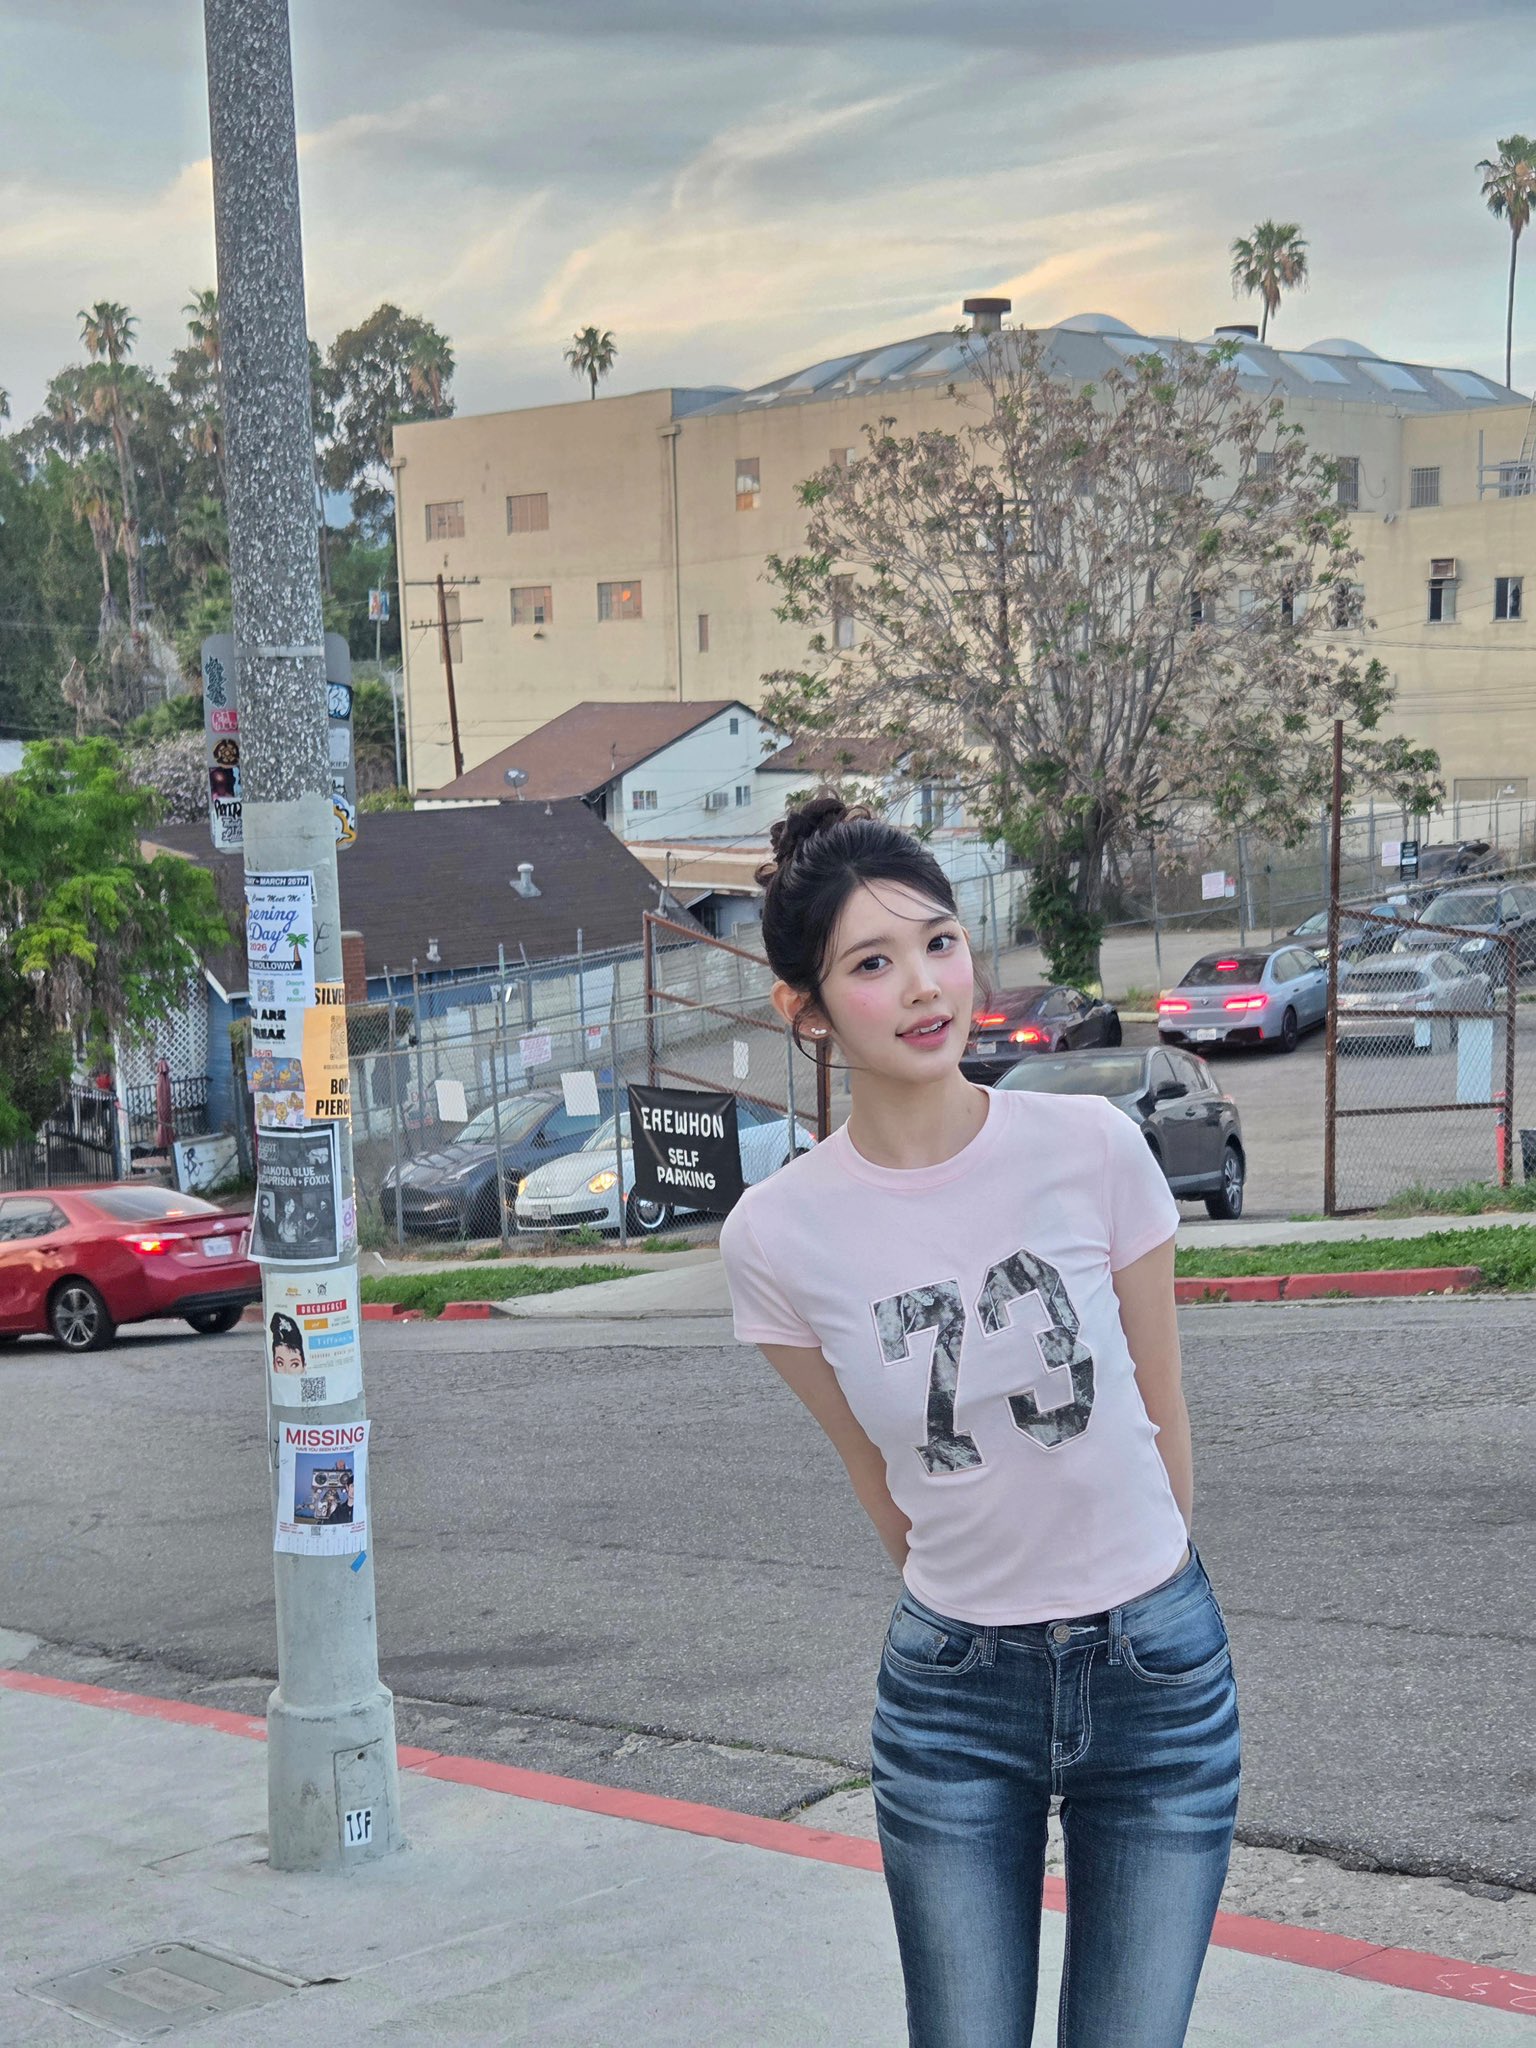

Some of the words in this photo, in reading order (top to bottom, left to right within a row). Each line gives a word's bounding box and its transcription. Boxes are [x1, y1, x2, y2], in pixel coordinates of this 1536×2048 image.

[260, 877, 286, 886] MARCH
[249, 922, 284, 954] Day
[254, 961, 296, 970] HOLLOWAY
[640, 1107, 724, 1138] EREWHON
[668, 1147, 699, 1167] SELF
[292, 1166, 315, 1177] BLUE
[303, 1174, 330, 1187] FOXIX
[656, 1165, 716, 1190] PARKING
[870, 1246, 1097, 1477] 73
[286, 1425, 364, 1446] MISSING
